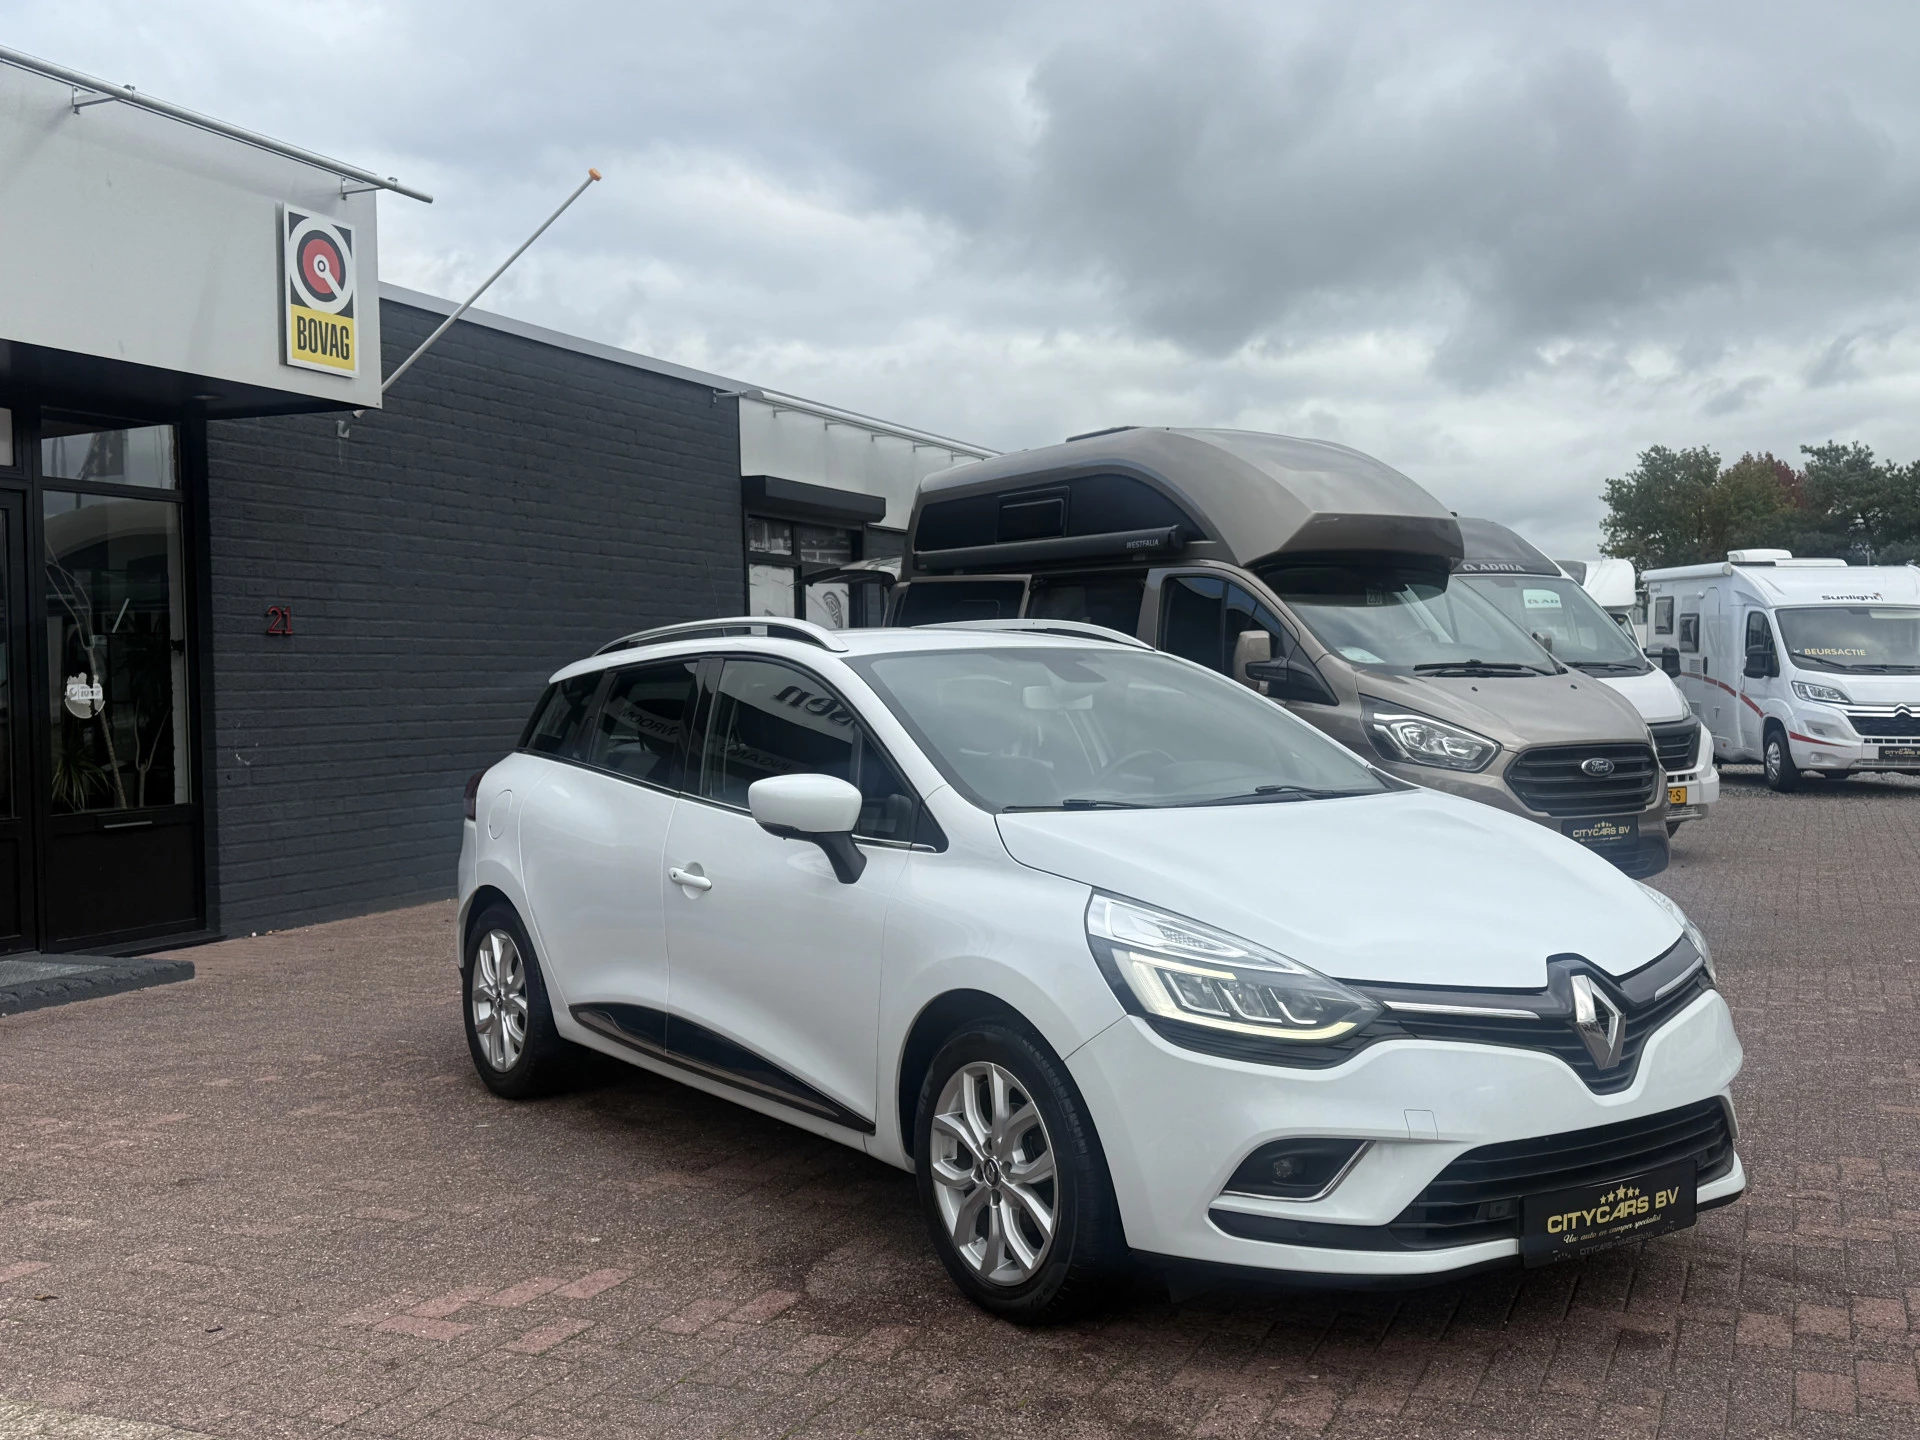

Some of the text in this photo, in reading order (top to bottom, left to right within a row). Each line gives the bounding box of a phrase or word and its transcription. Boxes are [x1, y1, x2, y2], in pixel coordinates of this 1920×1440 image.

[297, 315, 350, 360] BOVAG
[1126, 539, 1159, 549] WESTFALIA
[1480, 563, 1526, 572] ADRIA
[267, 605, 293, 634] 21
[1804, 648, 1867, 656] BEURSACTIE
[1591, 760, 1609, 771] Ford
[1572, 825, 1630, 838] CITYCARS BV
[1547, 1186, 1679, 1234] CITYCARS BV
[1580, 1231, 1597, 1240] auto
[1609, 1223, 1633, 1234] camper
[1634, 1213, 1661, 1229] specialist
